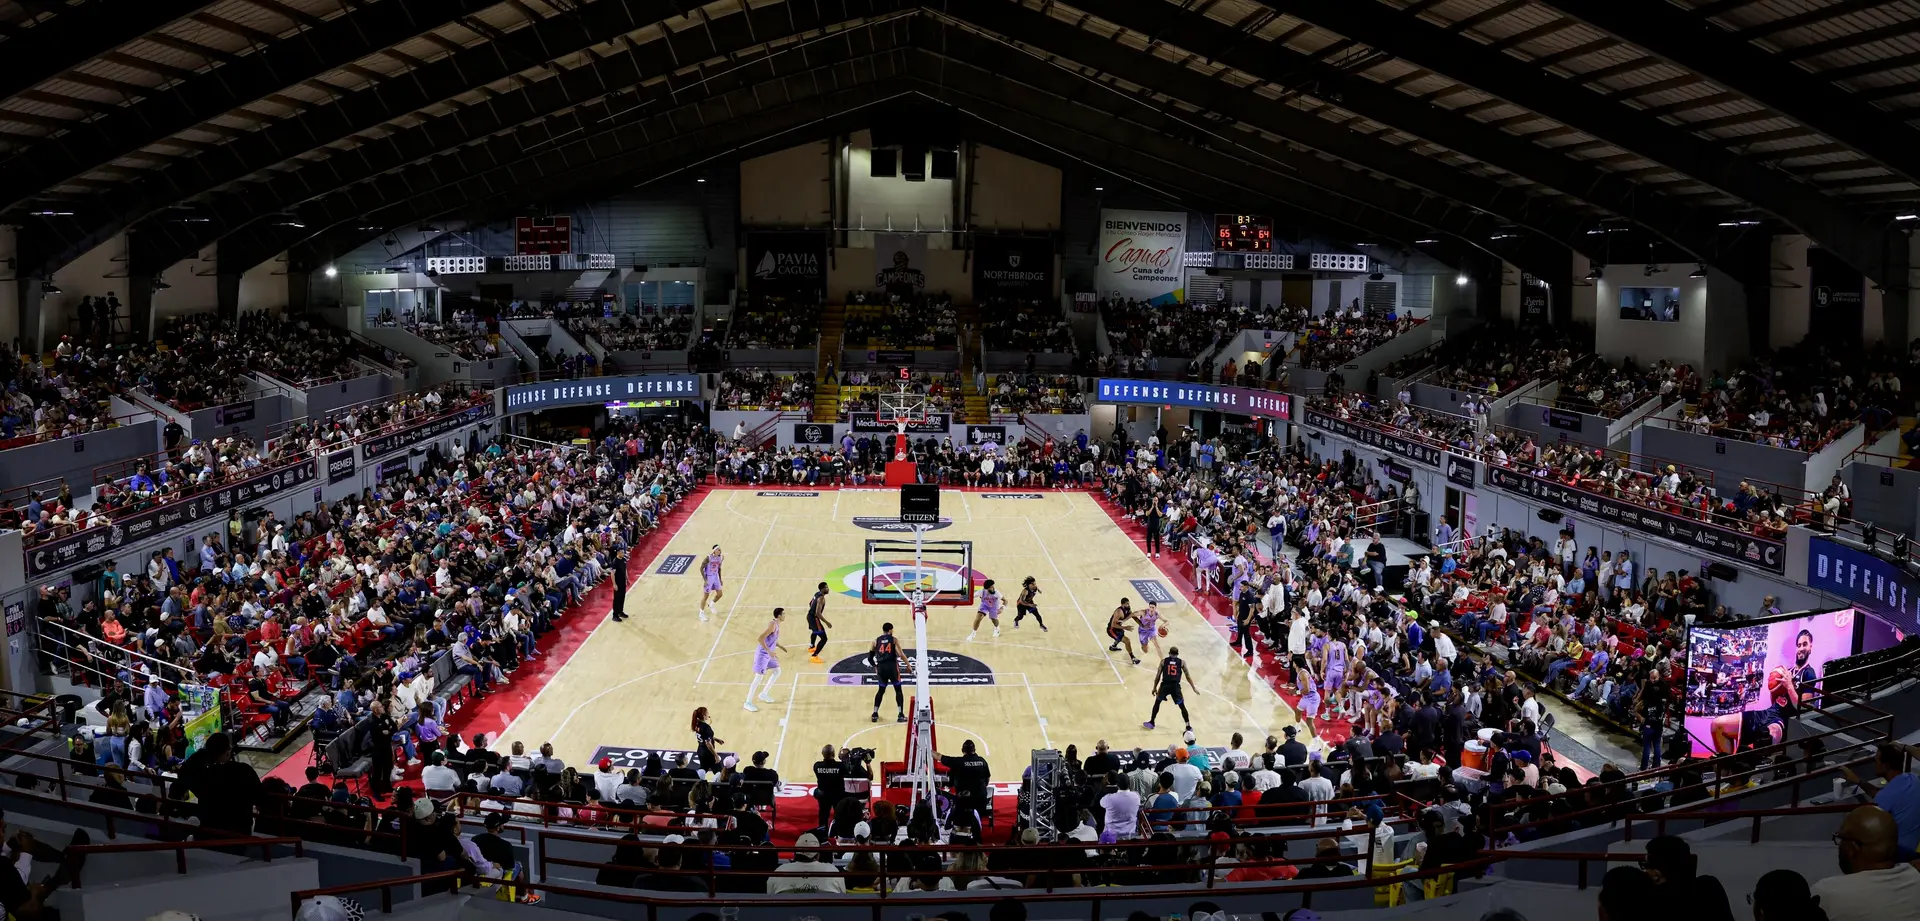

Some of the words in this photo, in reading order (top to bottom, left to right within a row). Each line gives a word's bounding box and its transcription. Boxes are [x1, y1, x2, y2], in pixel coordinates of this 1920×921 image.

[1105, 221, 1182, 233] BIENVENIDOS
[1219, 228, 1231, 238] 65
[1258, 229, 1270, 239] 64
[777, 252, 818, 266] PAVIA
[1104, 237, 1174, 274] Caguas
[777, 266, 819, 275] CAGUAS
[983, 270, 1046, 281] NORTHBRIDGE
[1132, 267, 1153, 275] Cuna
[1154, 267, 1165, 275] de
[875, 271, 925, 288] CAMPEONES
[1132, 274, 1179, 283] Campeones
[900, 368, 910, 379] 15
[553, 384, 611, 400] DEFENSE
[627, 380, 693, 394] DEFENSE
[1103, 385, 1169, 399] DEFENSE
[1178, 388, 1237, 405] DEFENSE
[329, 457, 353, 473] PREMIER
[902, 513, 936, 521] CITIZEN
[1620, 510, 1638, 520] crumbl
[129, 519, 153, 534] PREMIER
[1642, 517, 1662, 528] QDOBA
[1703, 537, 1716, 547] Coop
[1704, 532, 1718, 541] Buena
[58, 541, 80, 554] CHARLIE
[1817, 554, 1907, 615] DEFENSE
[879, 643, 892, 654] 44
[1167, 665, 1178, 676] 15
[964, 760, 984, 768] SECURITY
[817, 767, 840, 775] SECURITY
